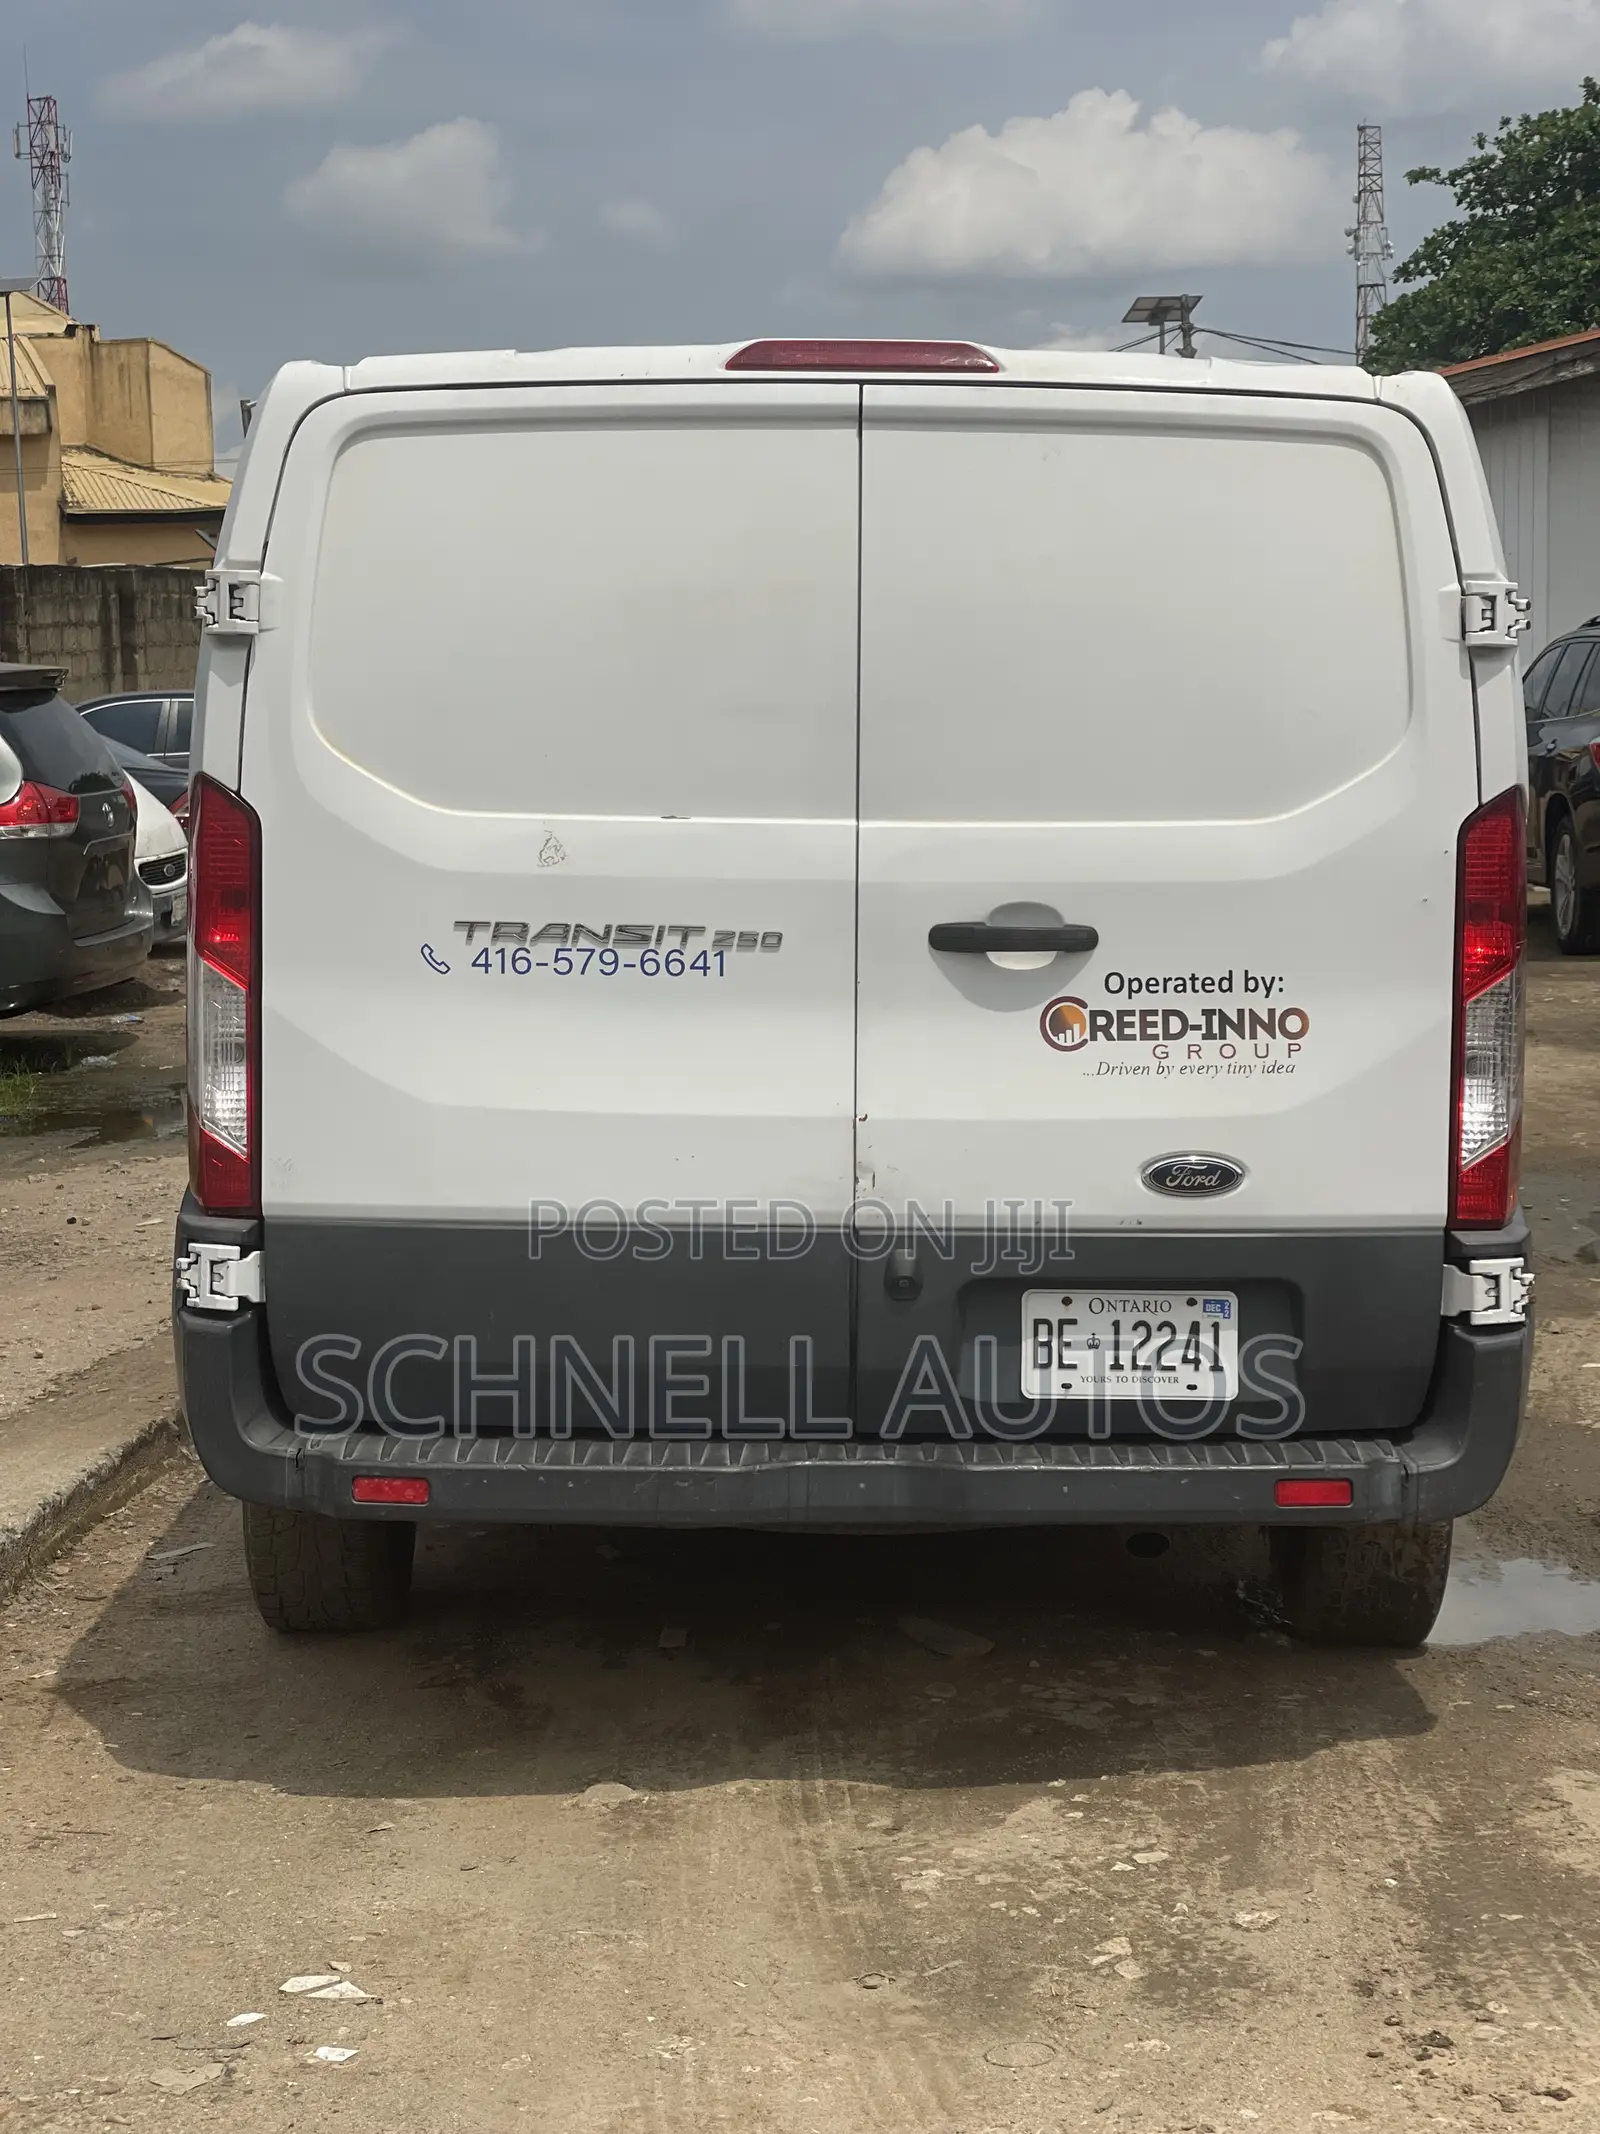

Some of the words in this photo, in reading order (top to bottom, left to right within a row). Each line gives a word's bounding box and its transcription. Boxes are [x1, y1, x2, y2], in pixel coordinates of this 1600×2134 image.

[453, 921, 706, 948] TRANSIT
[711, 930, 784, 951] 250
[471, 947, 725, 977] 416-579-6641
[1104, 970, 1234, 999] Operated
[1243, 970, 1285, 999] by:
[1151, 1043, 1303, 1060] GROUP
[1156, 1061, 1175, 1079] by
[1179, 1064, 1224, 1079] every
[1227, 1062, 1257, 1079] tiny
[1260, 1061, 1296, 1076] idea
[1165, 1163, 1222, 1187] Ford
[1205, 1303, 1221, 1313] DEC
[1033, 1318, 1078, 1370] BE
[1109, 1319, 1224, 1372] 12241
[1080, 1375, 1112, 1384] YOURS
[1115, 1375, 1129, 1384] TO
[1132, 1375, 1180, 1385] DISCOVER
